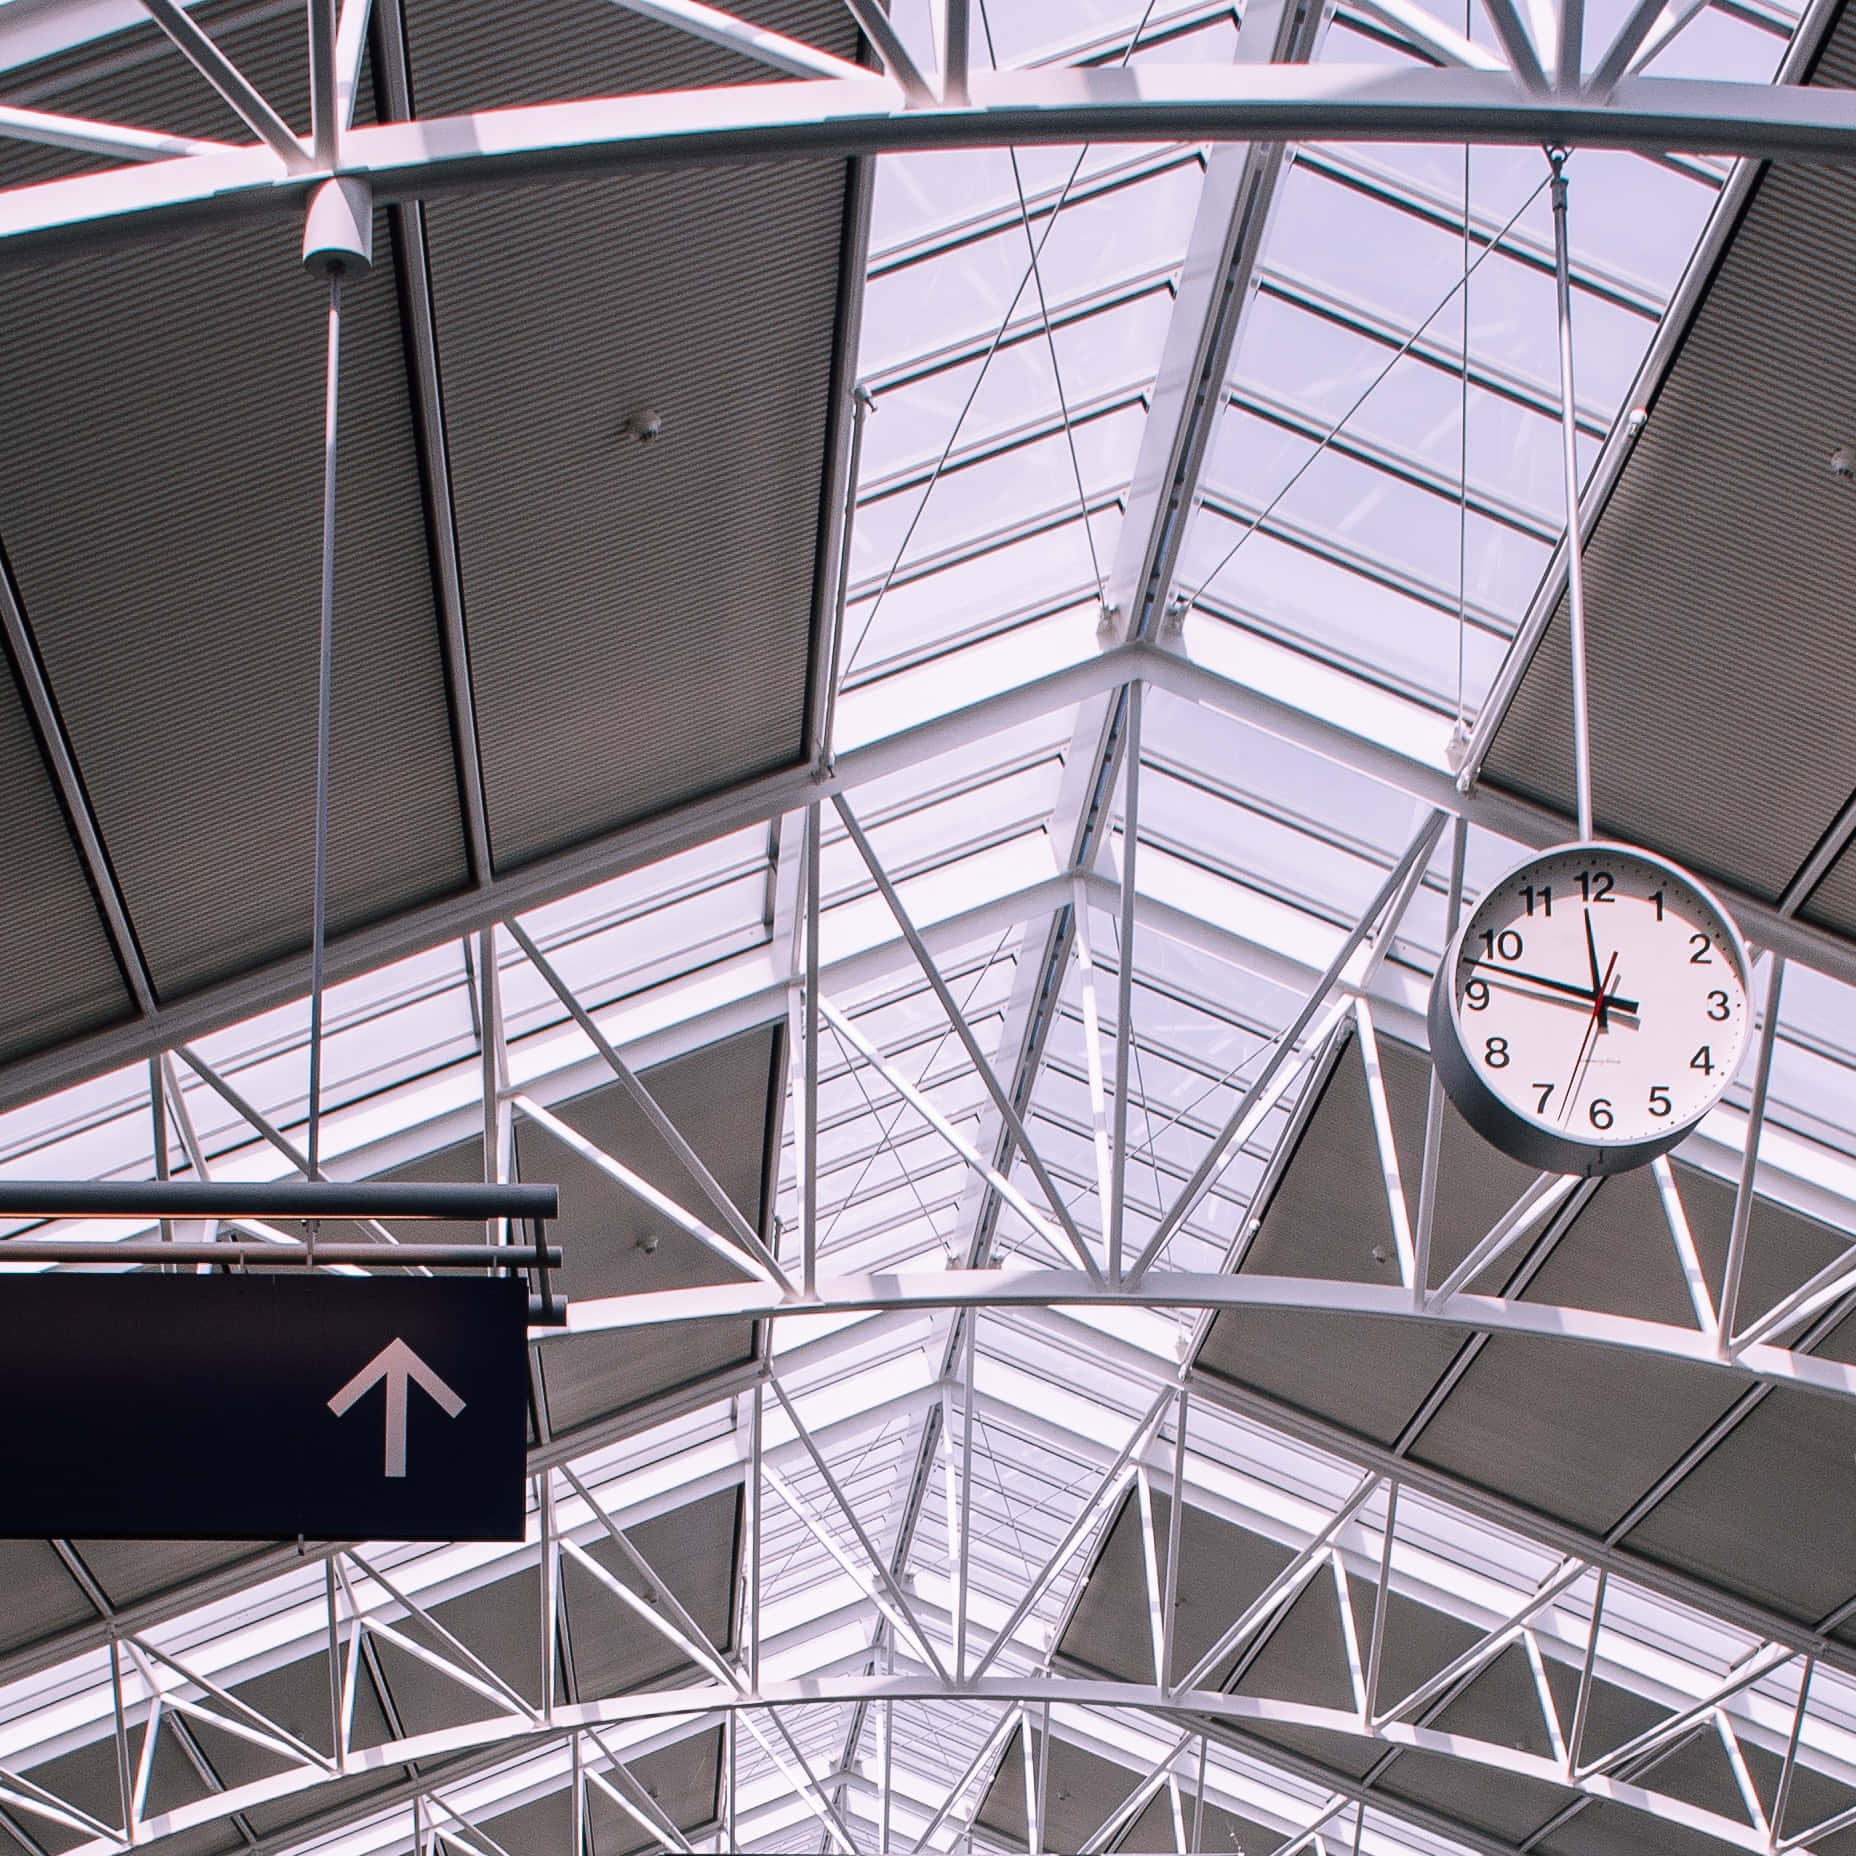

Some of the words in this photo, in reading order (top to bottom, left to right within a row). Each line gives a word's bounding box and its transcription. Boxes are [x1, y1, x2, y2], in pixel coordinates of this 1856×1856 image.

[1519, 885, 1552, 916] 11
[1574, 871, 1614, 902] 12
[1648, 891, 1664, 921] 1
[1479, 929, 1523, 960] 10
[1689, 933, 1712, 964] 2
[1465, 981, 1490, 1011] 9
[1707, 990, 1730, 1021] 3
[1485, 1037, 1510, 1068] 8
[1690, 1046, 1715, 1076] 4
[1532, 1083, 1555, 1114] 7
[1648, 1086, 1672, 1116] 5
[1589, 1099, 1614, 1130] 6
